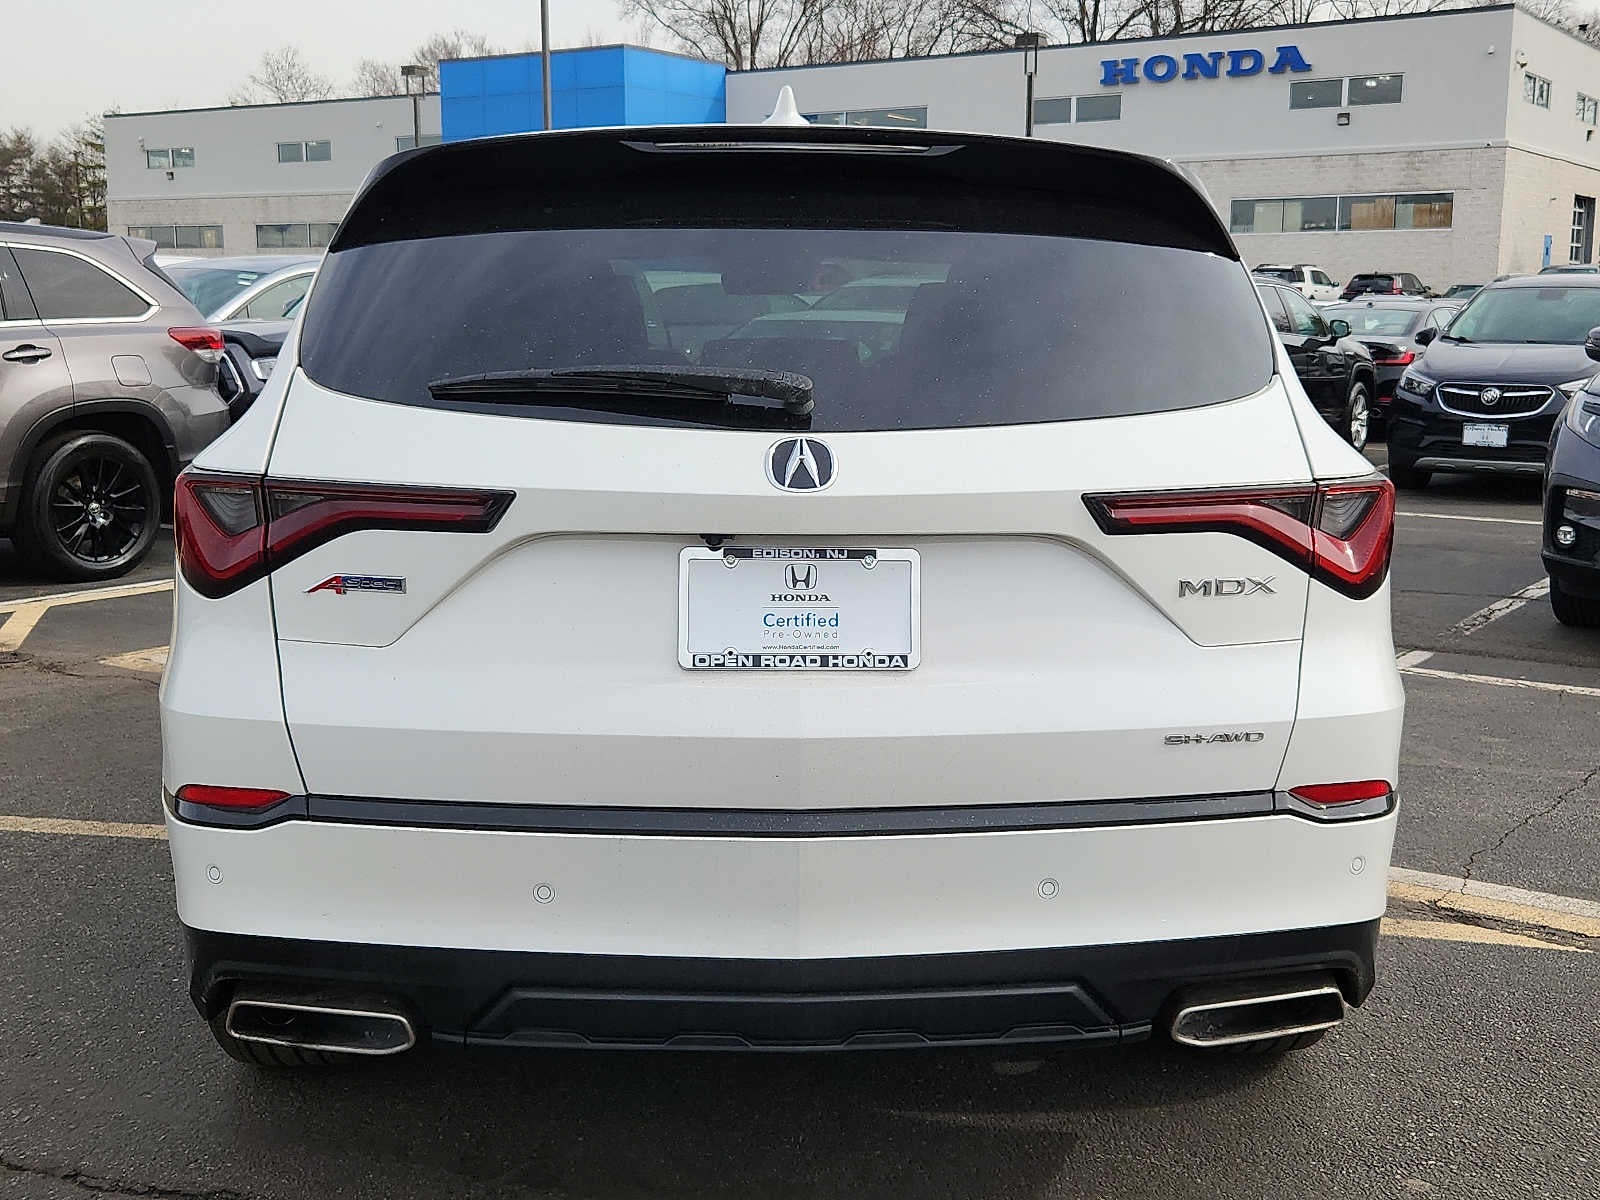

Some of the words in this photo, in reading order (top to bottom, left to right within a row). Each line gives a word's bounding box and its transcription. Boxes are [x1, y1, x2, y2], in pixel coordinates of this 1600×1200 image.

[1100, 45, 1313, 86] HONDA
[752, 549, 820, 559] EDISON,
[826, 549, 848, 559] NJ
[1178, 575, 1277, 598] MDX
[770, 593, 831, 602] HONDA
[763, 612, 839, 627] Certified
[763, 630, 838, 639] Pre-Owned
[694, 655, 753, 667] OPEN
[760, 655, 821, 667] ROAD
[829, 655, 905, 667] HONDA
[1164, 732, 1264, 745] SH-AWD
